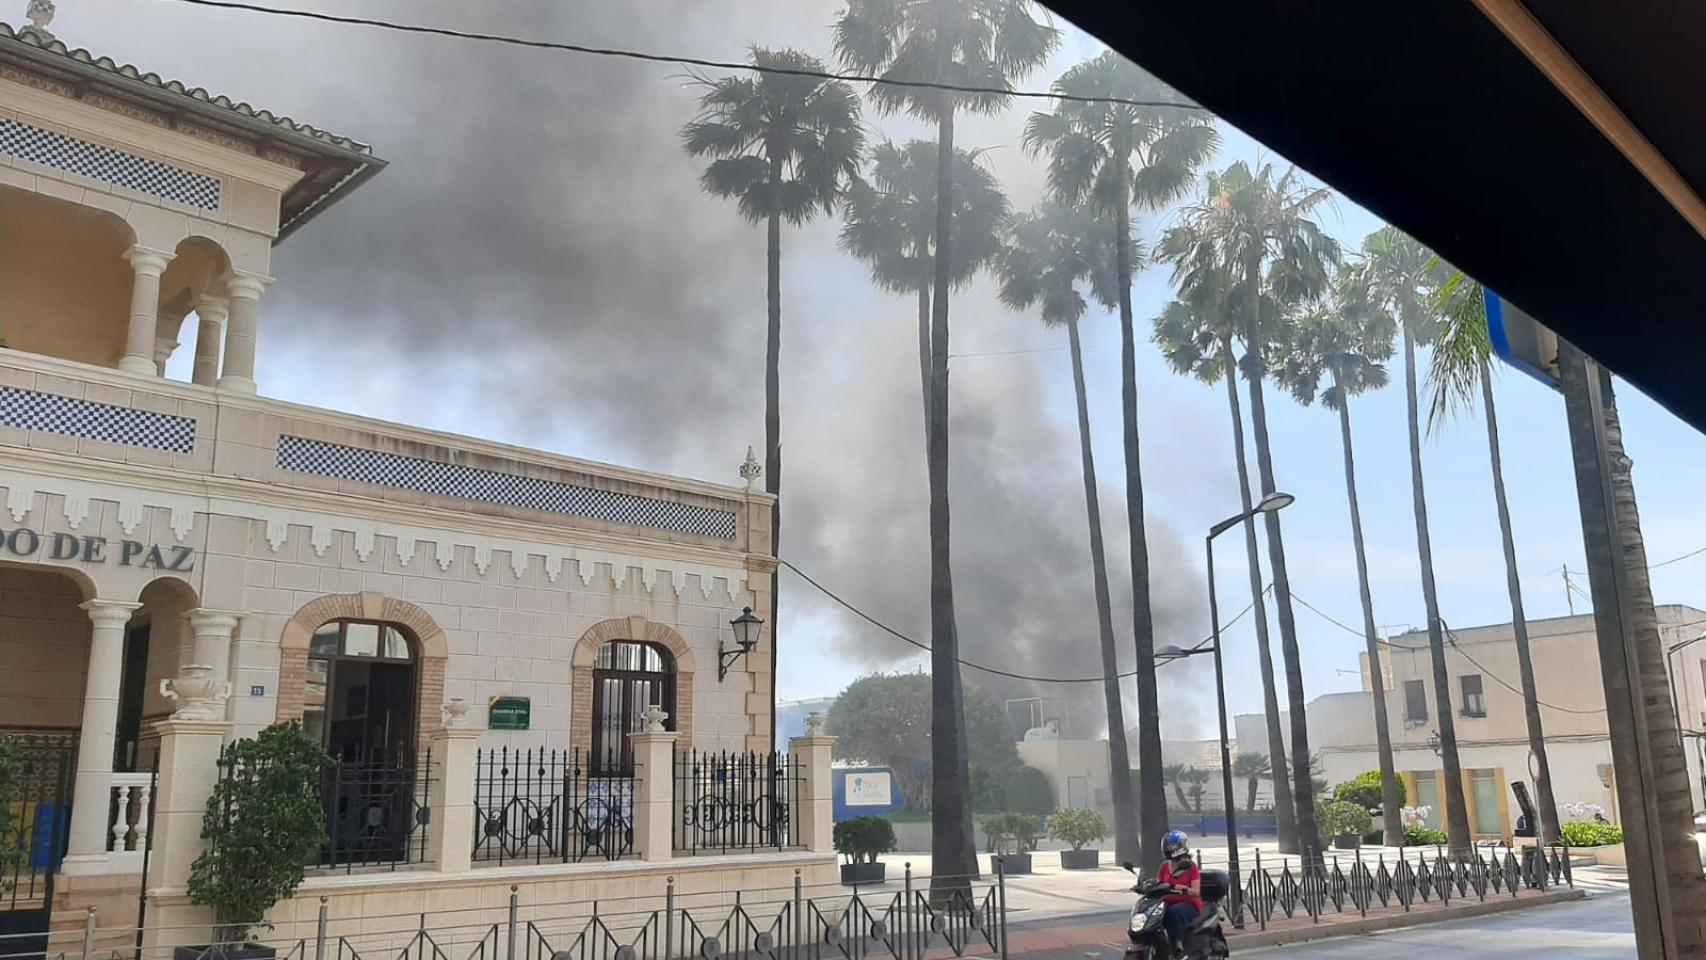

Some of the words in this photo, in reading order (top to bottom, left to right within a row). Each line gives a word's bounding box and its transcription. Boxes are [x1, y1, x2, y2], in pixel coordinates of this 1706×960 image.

[0, 527, 39, 556] O
[48, 532, 107, 564] DE
[118, 539, 195, 572] PAZ
